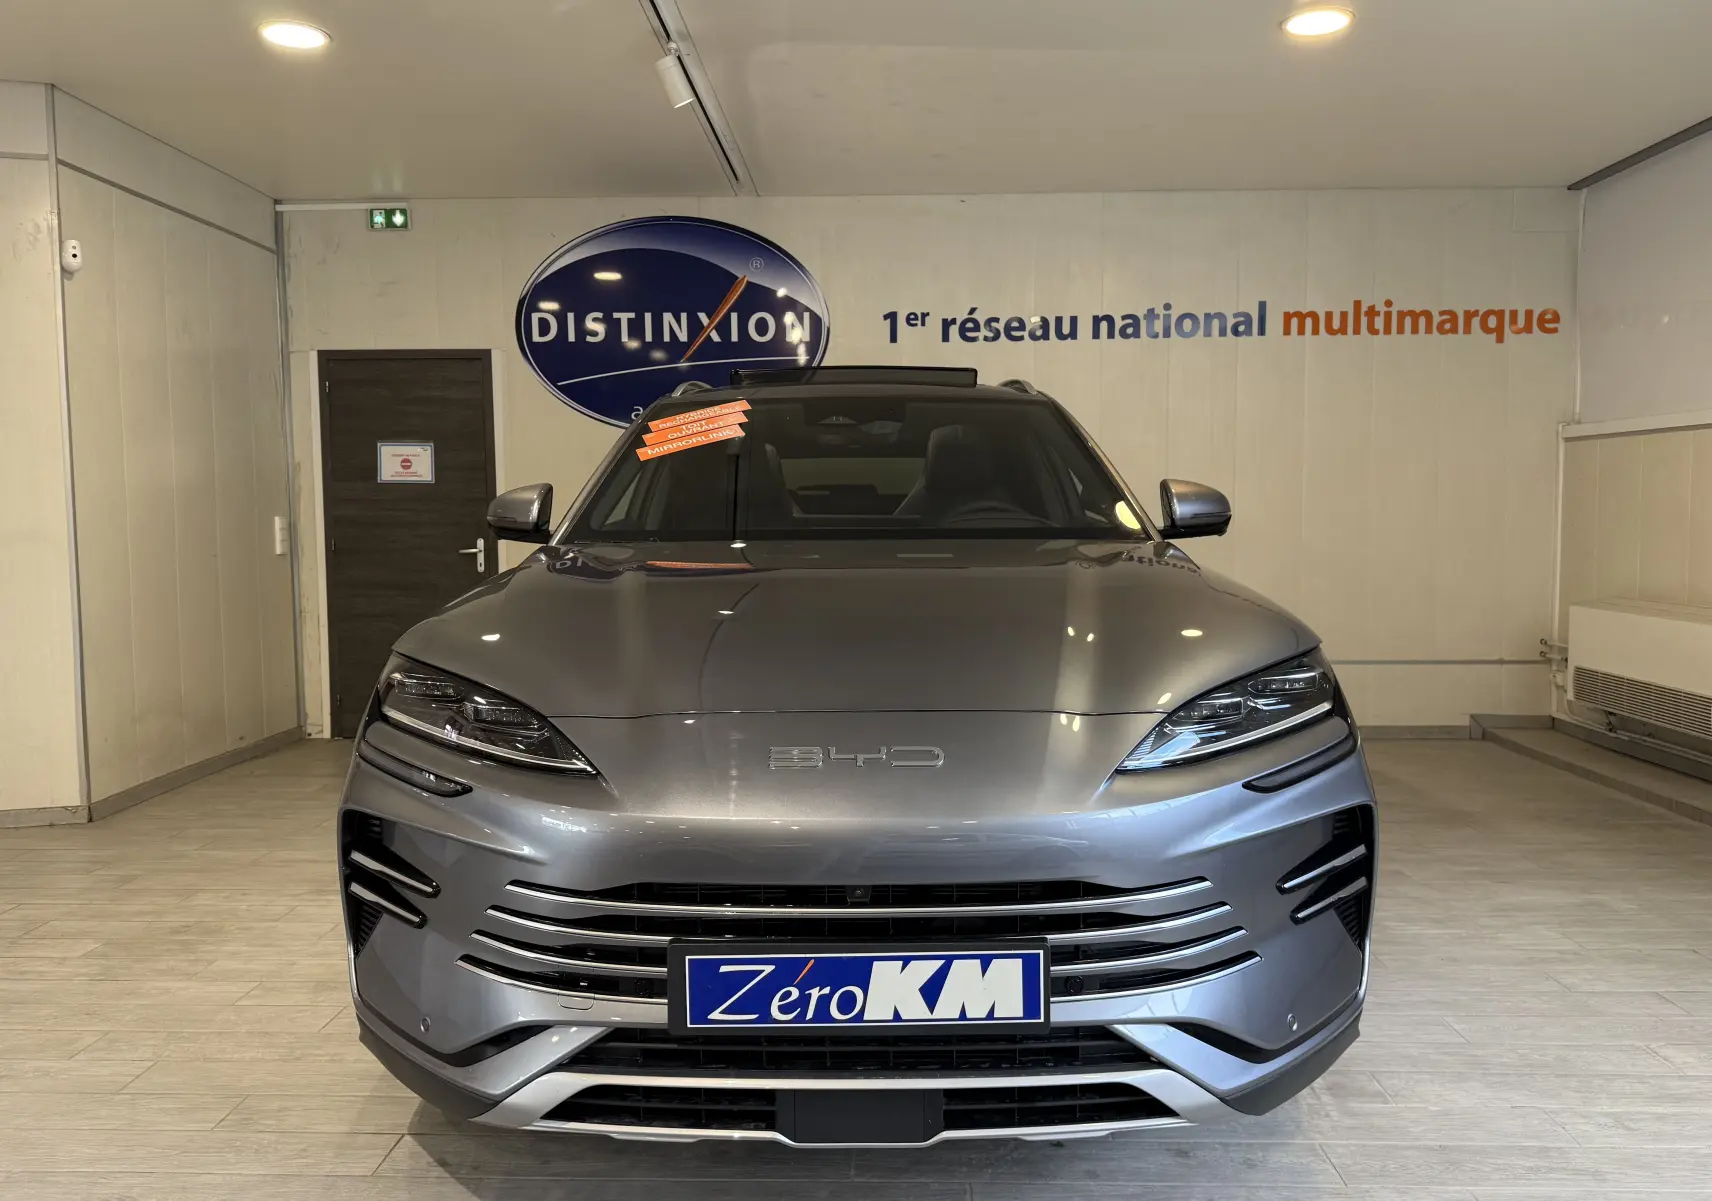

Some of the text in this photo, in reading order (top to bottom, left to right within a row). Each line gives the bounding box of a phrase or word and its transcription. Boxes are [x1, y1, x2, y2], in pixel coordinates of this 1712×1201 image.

[531, 311, 811, 343] DISTINXION
[882, 299, 1561, 344] 1er réseau national multimarque
[659, 406, 741, 429] RECHARGEABLE
[676, 406, 721, 420] HYBRIDE
[667, 421, 725, 439] OUVRANT
[681, 420, 707, 431] TOIT
[647, 430, 735, 455] MIRRORLINK
[769, 745, 945, 769] BYD
